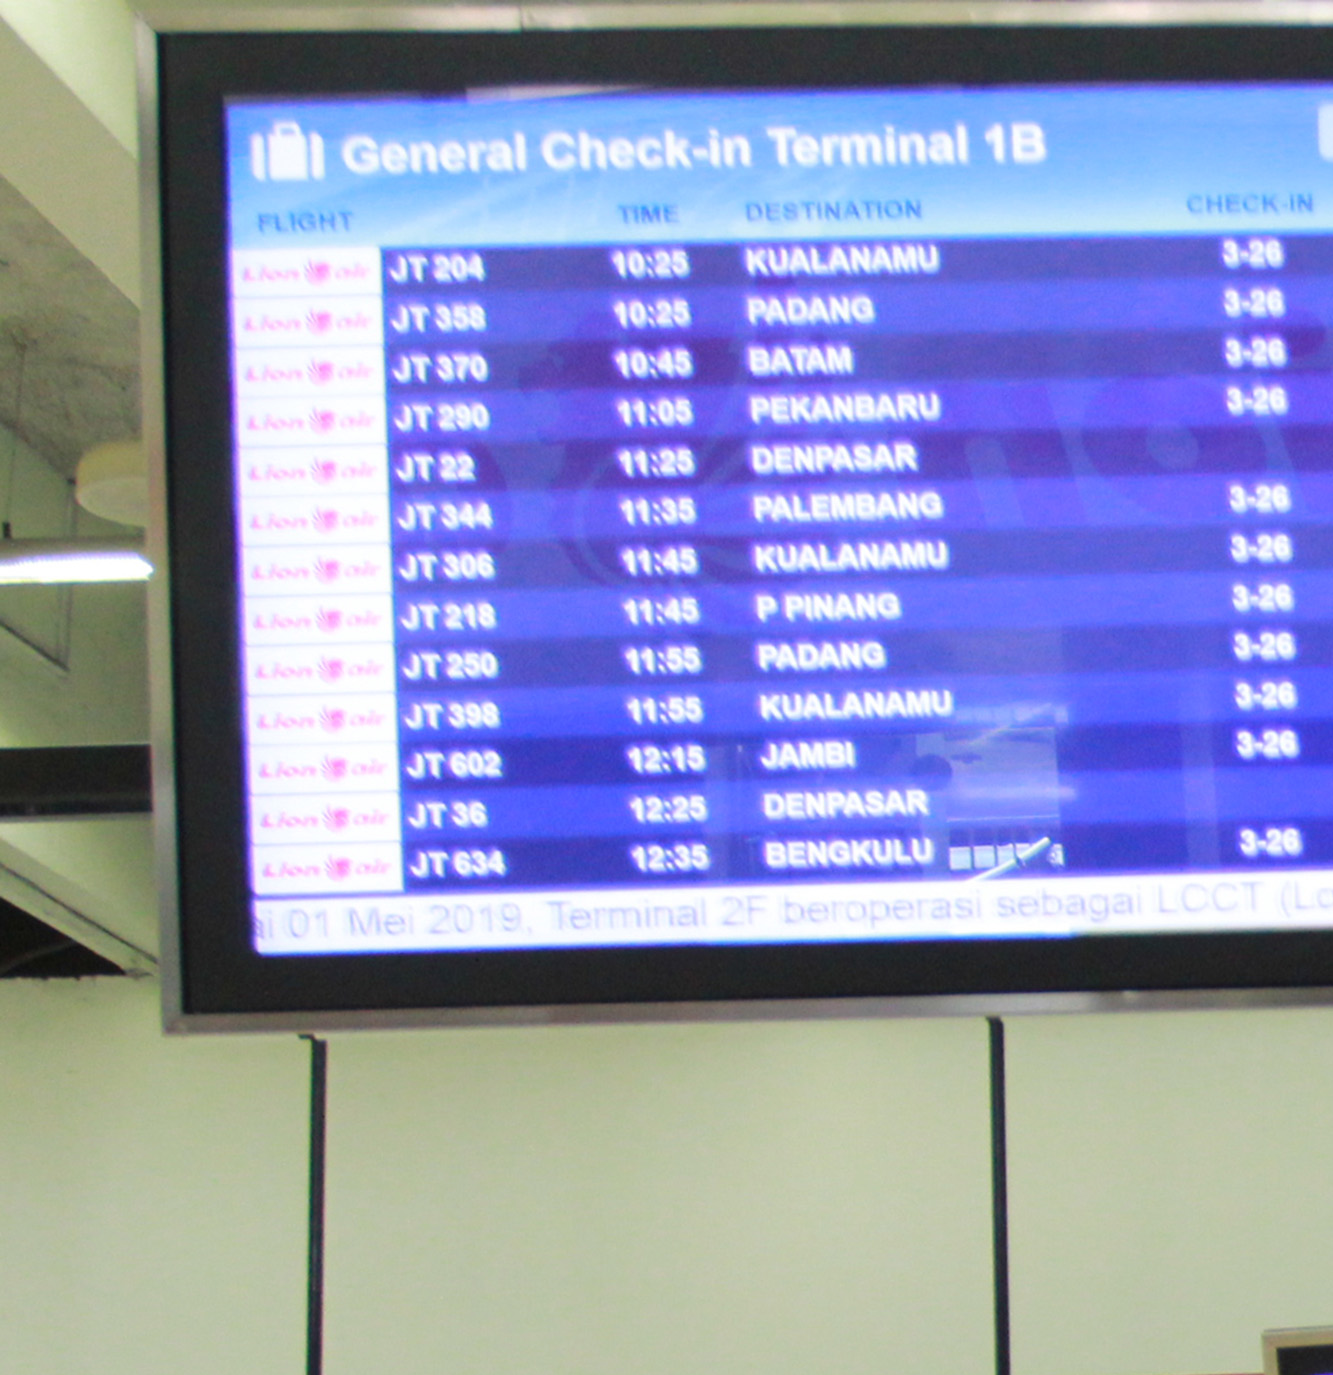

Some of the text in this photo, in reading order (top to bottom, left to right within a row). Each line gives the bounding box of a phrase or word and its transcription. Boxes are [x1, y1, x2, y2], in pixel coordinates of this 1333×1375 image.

[342, 121, 1048, 176] General Check-in Terminal 1B
[257, 211, 353, 234] FLIGHT
[619, 204, 680, 226] TIME
[746, 200, 923, 224] DESTINATION
[1187, 193, 1314, 215] CHECK-IN
[391, 257, 430, 283] JT
[435, 255, 485, 282] 204
[613, 251, 689, 277] 10:25
[747, 246, 940, 274] KUALANAMU
[1222, 240, 1284, 267] 3-26
[394, 354, 433, 382] JT
[438, 352, 488, 381] 370
[615, 348, 693, 378] 10:45
[748, 345, 853, 375] BATAM
[1225, 337, 1288, 367] 3-26
[400, 502, 438, 530] JT
[441, 499, 494, 529] 344
[620, 496, 697, 525] 11:35
[752, 491, 946, 523] PALEMBANG
[1229, 483, 1293, 513] 3-26
[402, 602, 442, 630] JT
[446, 599, 497, 629] 218
[622, 595, 701, 625] 11:45
[755, 594, 778, 622] P
[786, 591, 902, 620] PINANG
[1232, 582, 1295, 612] 3-26
[410, 849, 449, 878] JT
[453, 847, 507, 876] 634
[630, 843, 712, 873] 12:35
[765, 837, 934, 869] BENGKULU
[1239, 827, 1303, 857] 3-26
[350, 907, 415, 936] Mei
[547, 897, 706, 931] Terminal
[783, 890, 982, 927] beroperasi
[998, 886, 1142, 922] sebagai
